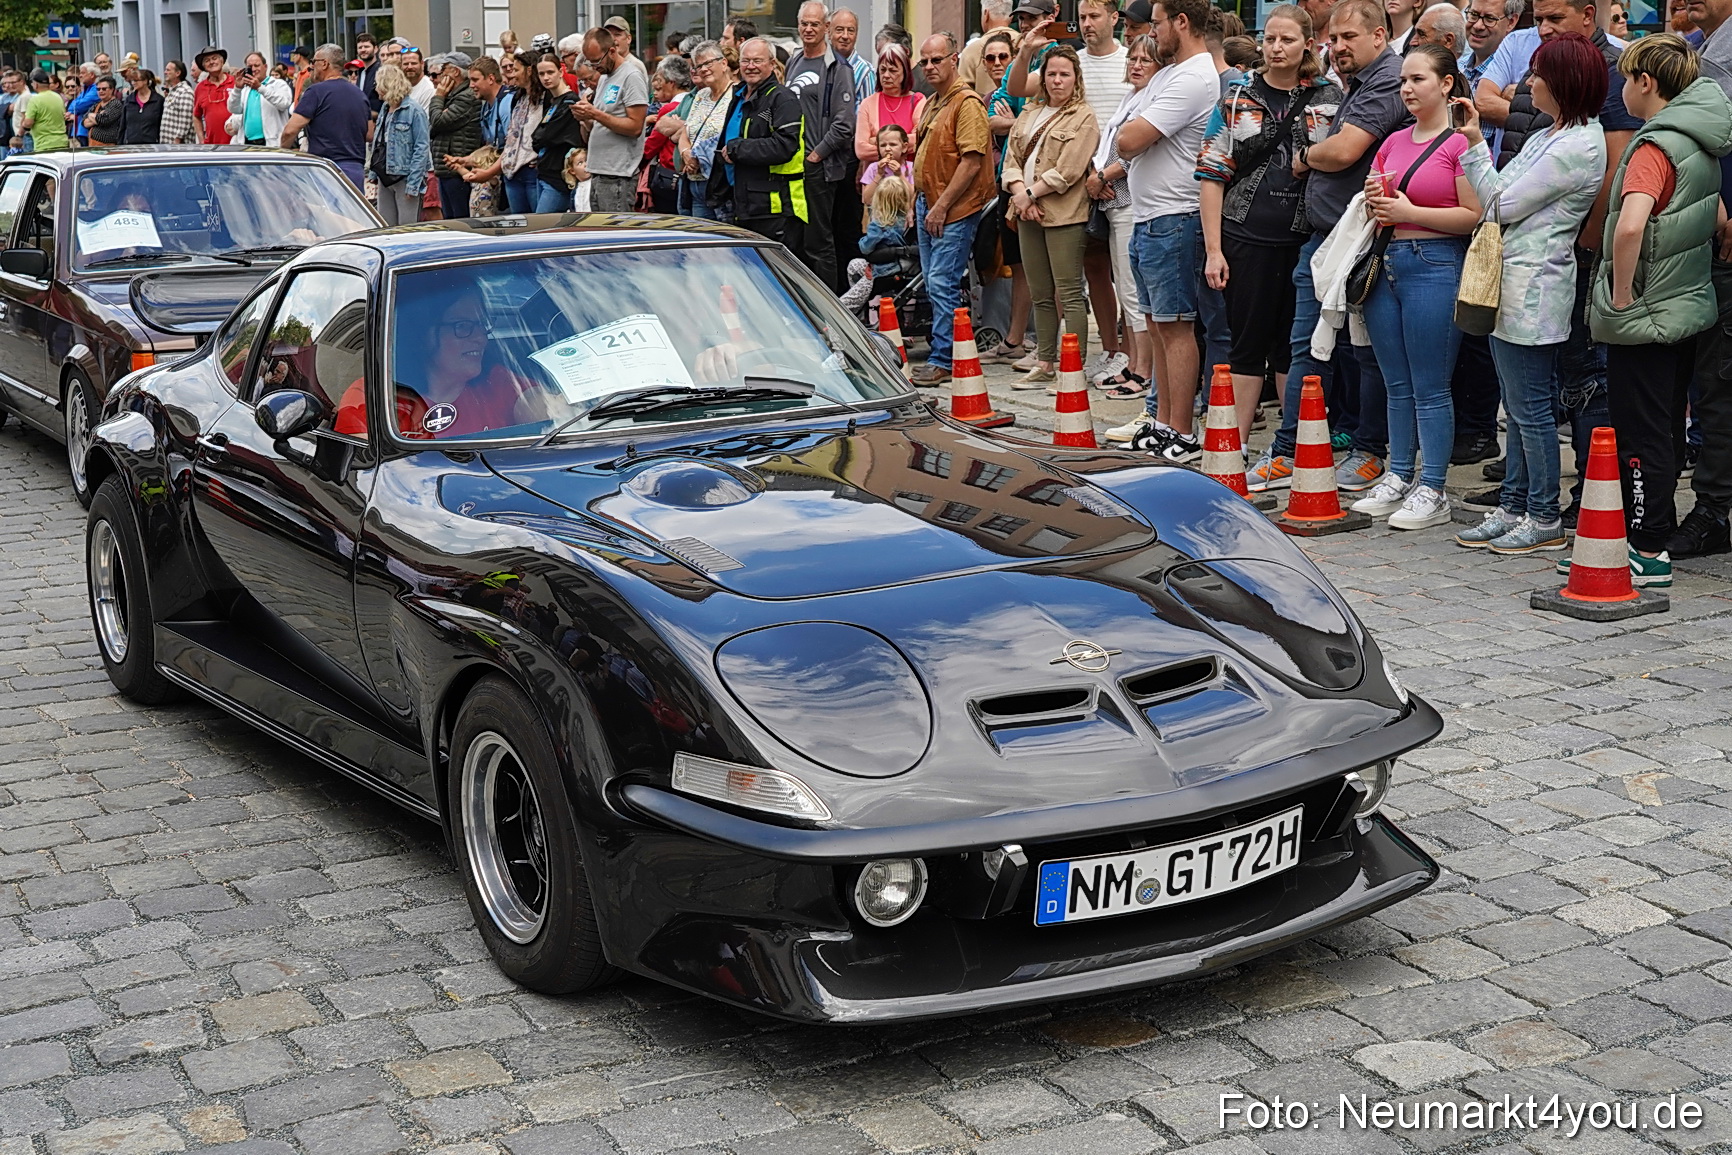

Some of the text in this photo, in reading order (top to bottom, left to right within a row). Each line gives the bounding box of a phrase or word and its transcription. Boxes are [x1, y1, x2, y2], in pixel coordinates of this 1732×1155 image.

[113, 217, 139, 226] 485
[601, 329, 647, 348] 211
[1068, 860, 1135, 914] NM
[1046, 900, 1058, 914] D
